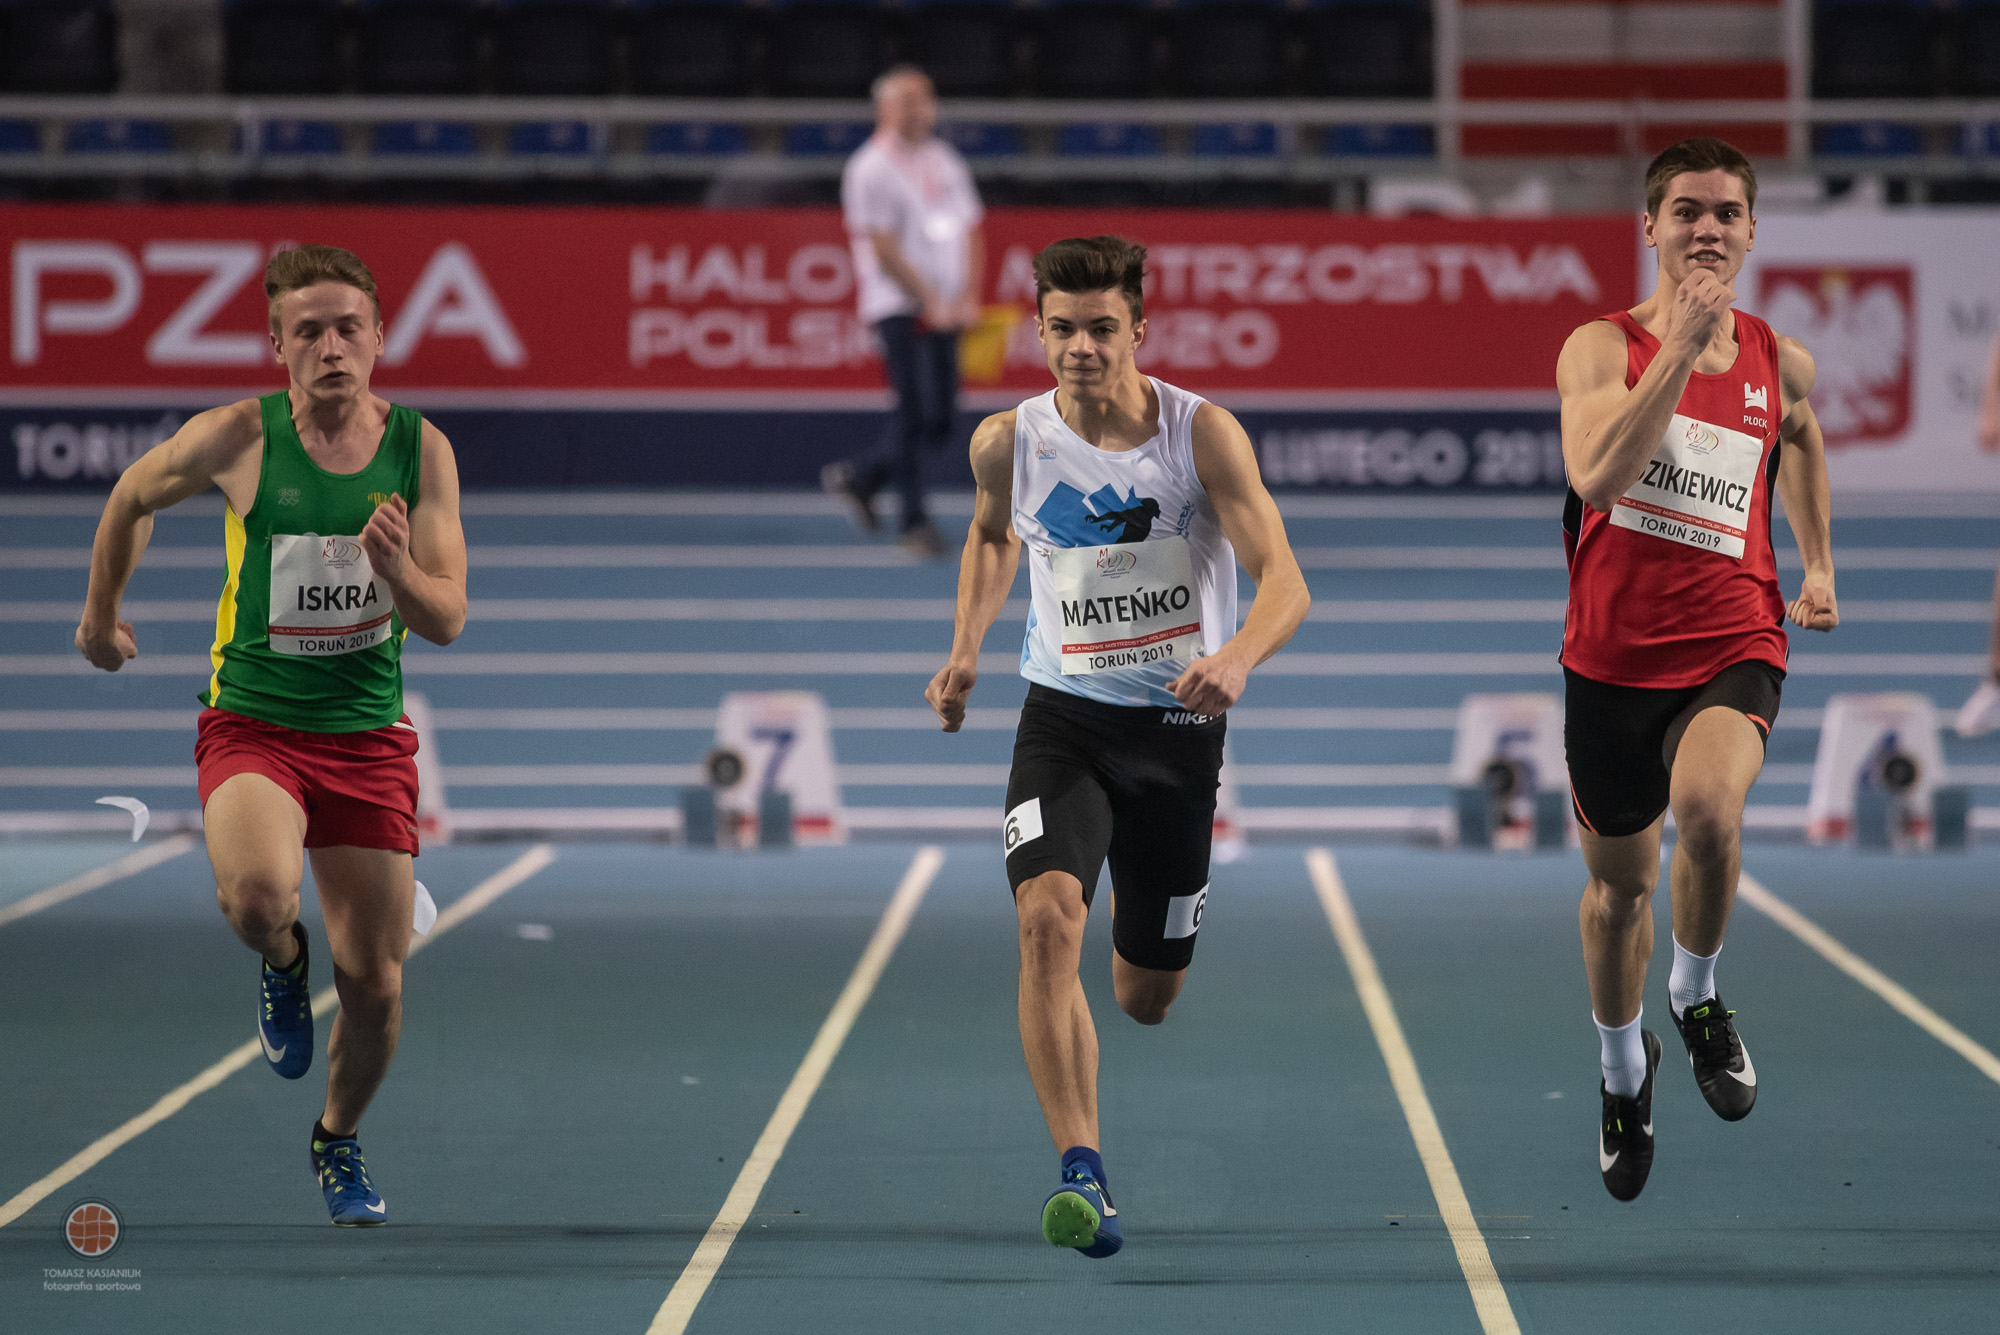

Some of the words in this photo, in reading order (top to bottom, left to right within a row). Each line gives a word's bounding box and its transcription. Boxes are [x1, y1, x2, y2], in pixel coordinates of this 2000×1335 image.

[630, 244, 858, 301] HALO
[10, 240, 526, 367] PZA
[1743, 415, 1767, 429] PŁOCK
[1638, 460, 1748, 513] ZIKIEWICZ
[1640, 516, 1687, 539] TORUŃ
[1689, 530, 1721, 548] 2019
[298, 581, 378, 612] ISKRA
[1061, 585, 1190, 627] MATEŃKO
[299, 636, 345, 651] TORUŃ
[349, 632, 376, 649] 2019
[1089, 649, 1137, 670] TORUŃ
[1142, 644, 1173, 663] 2019
[1162, 712, 1207, 725] NIKE
